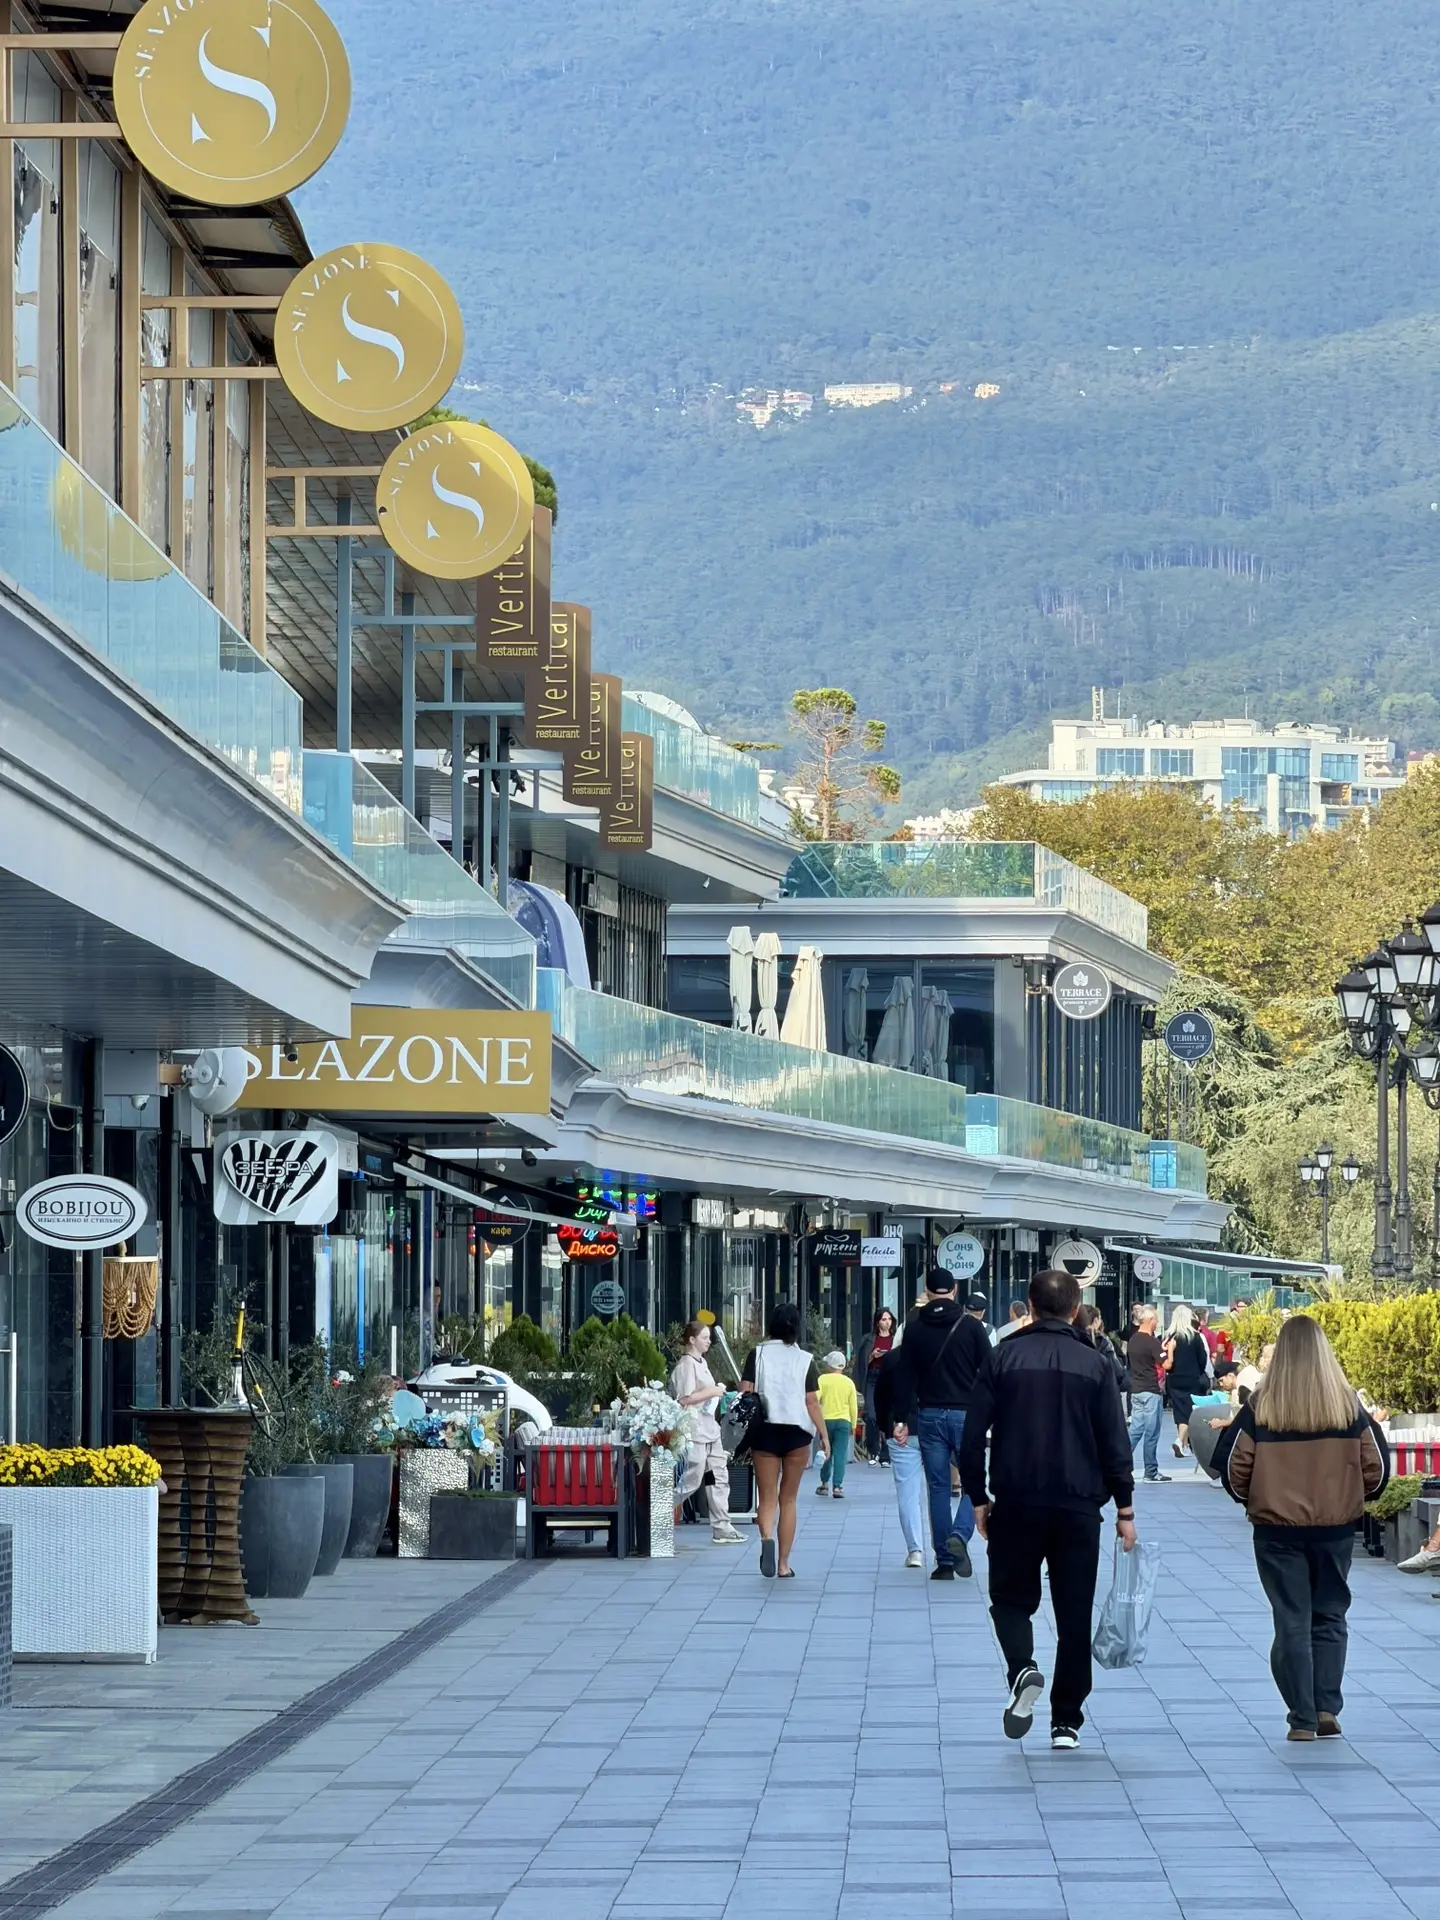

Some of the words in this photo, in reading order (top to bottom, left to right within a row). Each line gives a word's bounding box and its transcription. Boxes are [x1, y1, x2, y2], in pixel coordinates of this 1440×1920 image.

[292, 254, 372, 332] SEAZONE
[390, 432, 457, 496] SEAZONE
[488, 646, 538, 657] restaurant
[538, 613, 567, 719] Vertical
[536, 729, 580, 739] restaurant
[572, 786, 612, 796] restaurant
[608, 834, 644, 844] restaurant
[1060, 988, 1102, 997] TERRACE
[1172, 1034, 1207, 1042] TERRACE
[235, 1158, 315, 1177] ЗЕБРА
[256, 1182, 294, 1190] БУТИК
[37, 1200, 125, 1217] BOBIJOU
[490, 1226, 512, 1237] кафе
[946, 1240, 974, 1252] Соня
[956, 1252, 964, 1260] &
[945, 1258, 975, 1269] Ваня
[1141, 1259, 1154, 1270] 23
